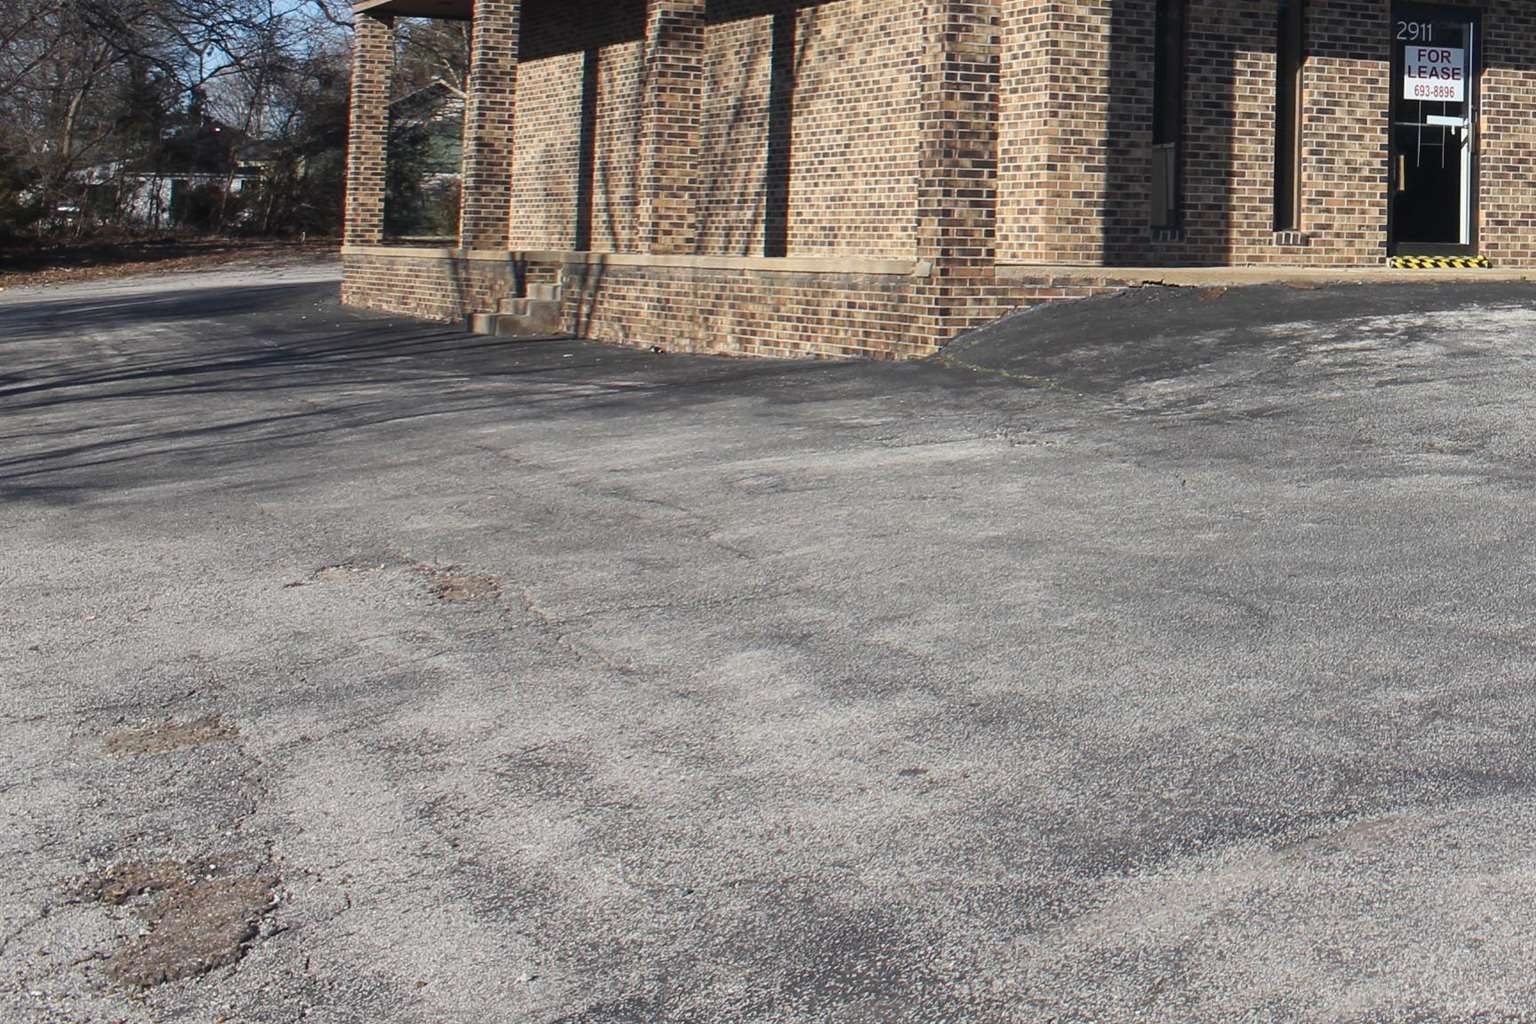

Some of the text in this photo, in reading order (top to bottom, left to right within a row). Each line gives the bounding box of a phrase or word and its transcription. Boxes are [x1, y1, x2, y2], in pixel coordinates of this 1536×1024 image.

[1396, 21, 1432, 42] 2911
[1417, 49, 1452, 64] FOR
[1408, 65, 1462, 81] LEASE
[1414, 84, 1455, 98] 693-8896
